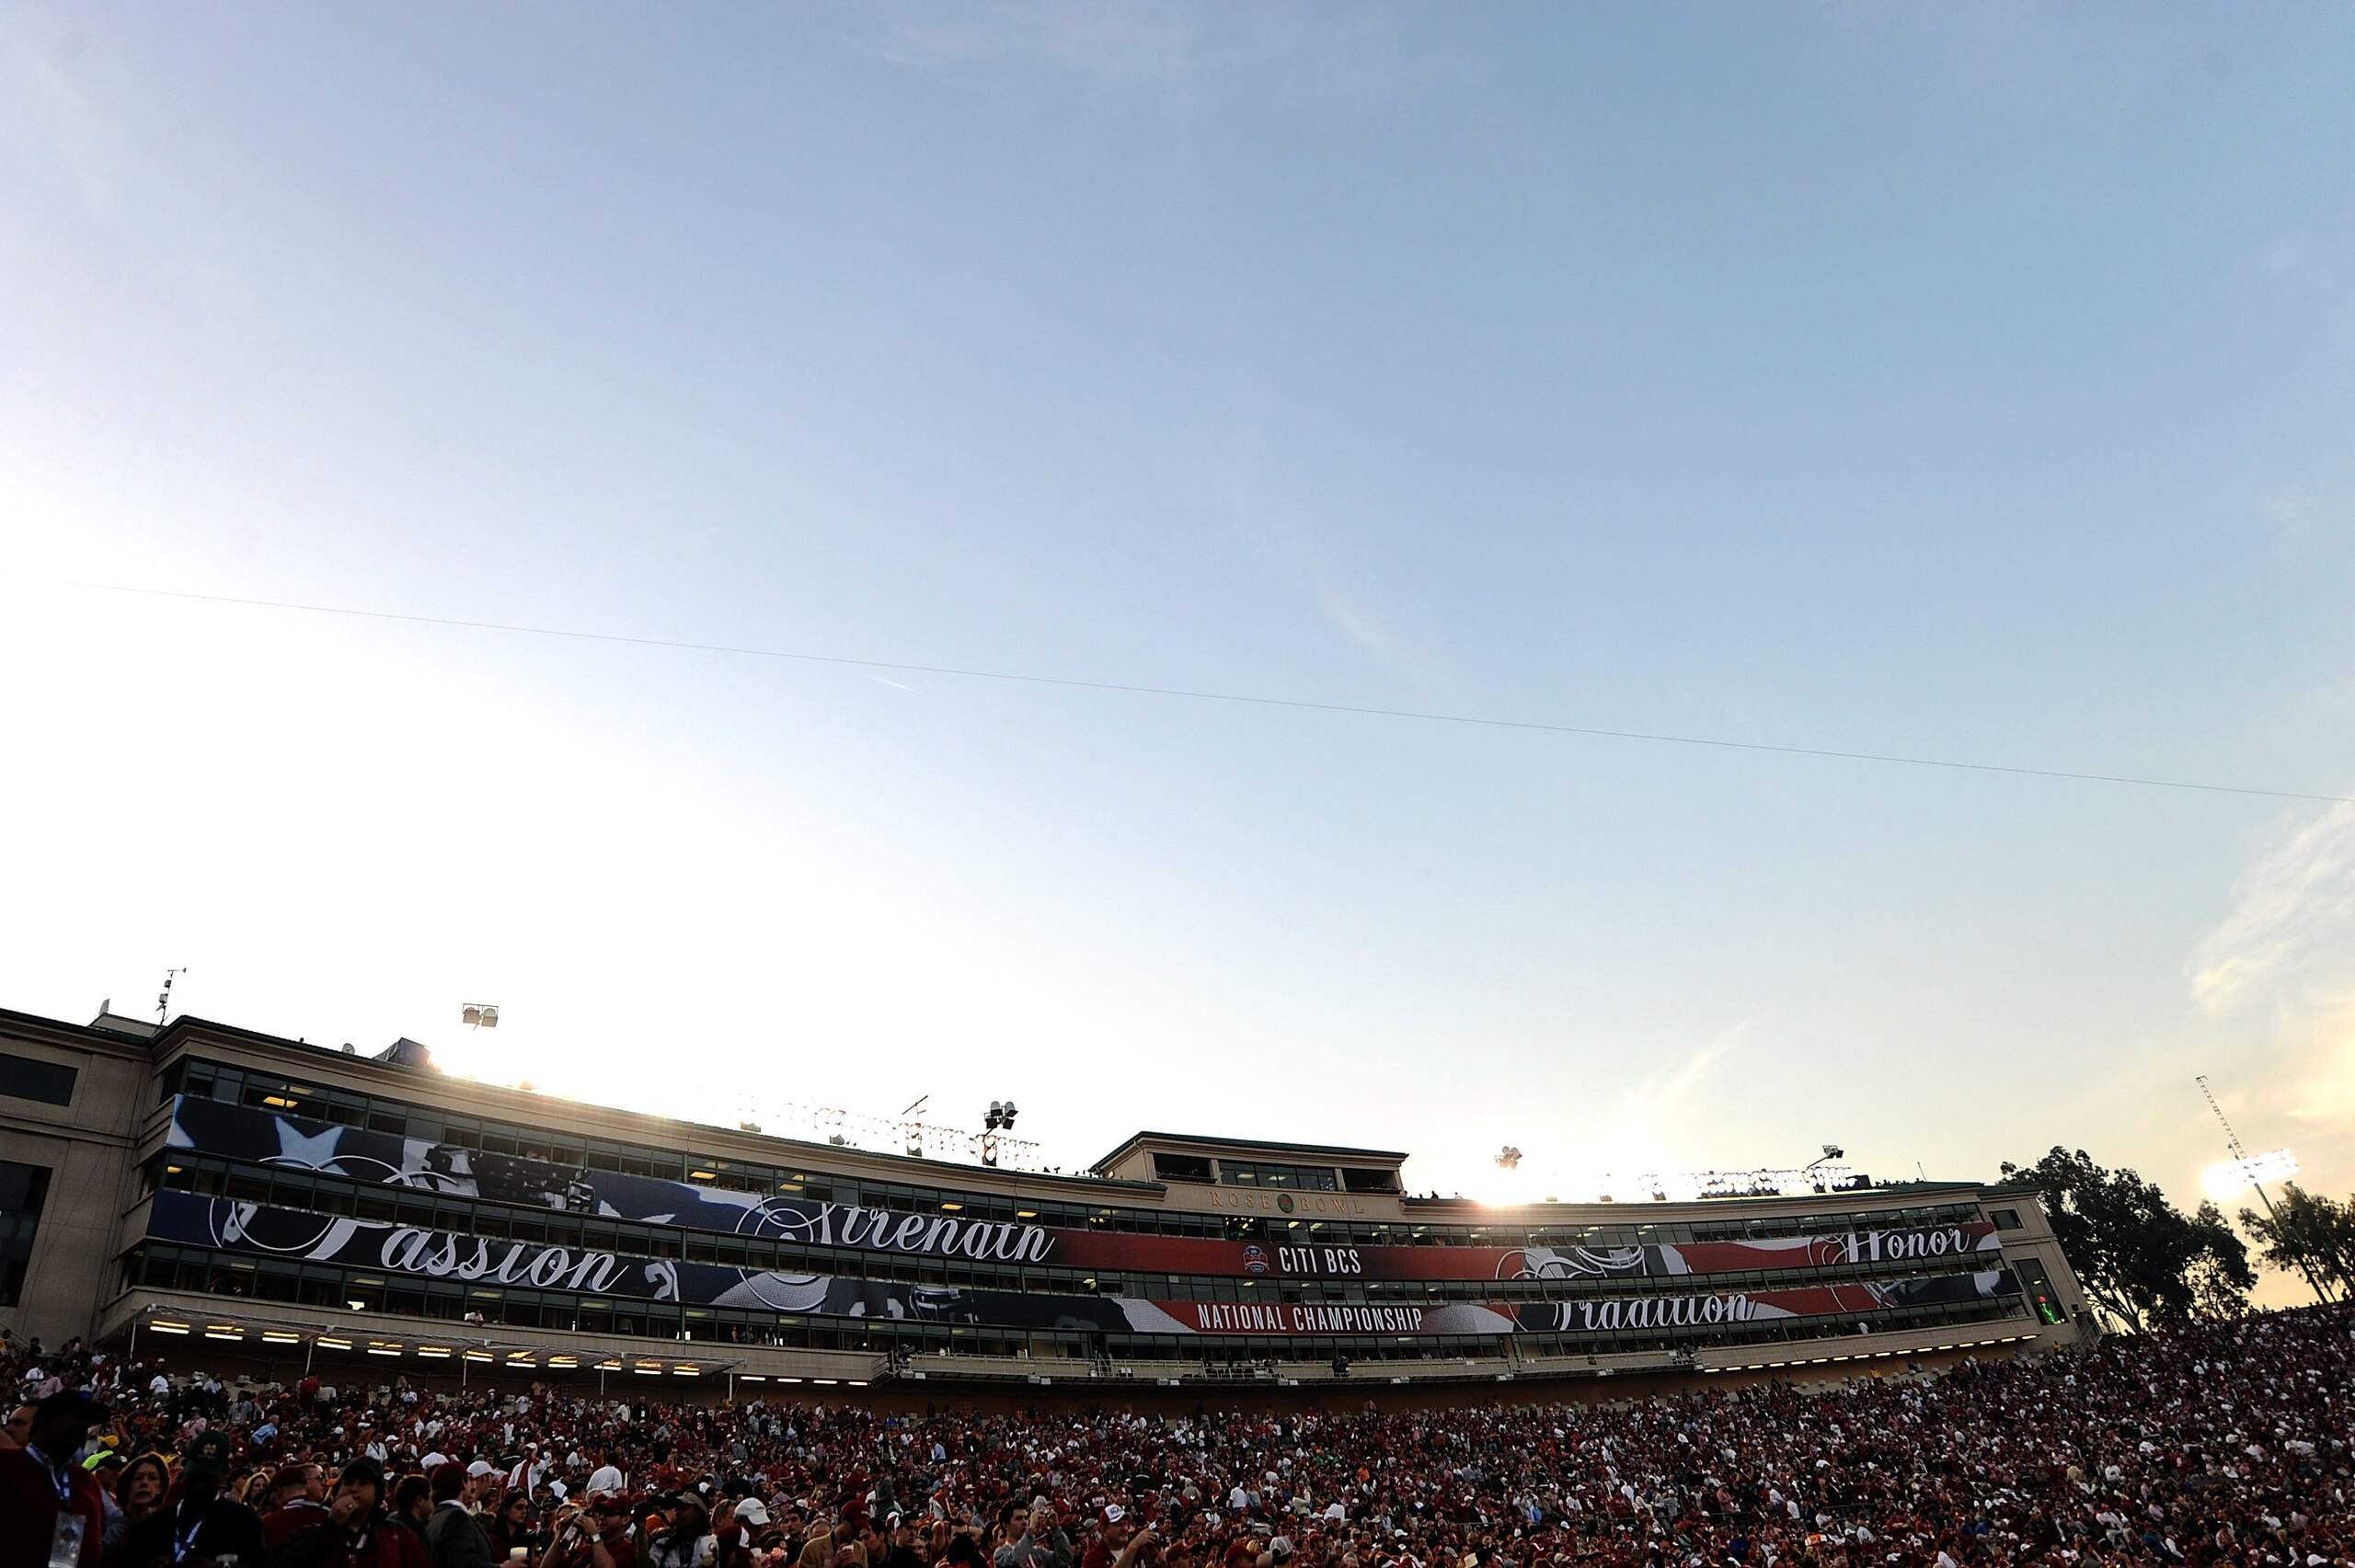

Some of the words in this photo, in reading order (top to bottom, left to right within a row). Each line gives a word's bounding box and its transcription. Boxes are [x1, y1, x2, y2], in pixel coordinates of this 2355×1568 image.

[1210, 1191, 1271, 1209] ROSE
[1301, 1196, 1364, 1214] BOWL
[1279, 1246, 1318, 1273] CITI
[1325, 1248, 1361, 1274] BCS
[1821, 1229, 1970, 1263] Honor
[1197, 1303, 1287, 1331] NATIONAL
[1292, 1306, 1423, 1332] CHAMPIONSHIP
